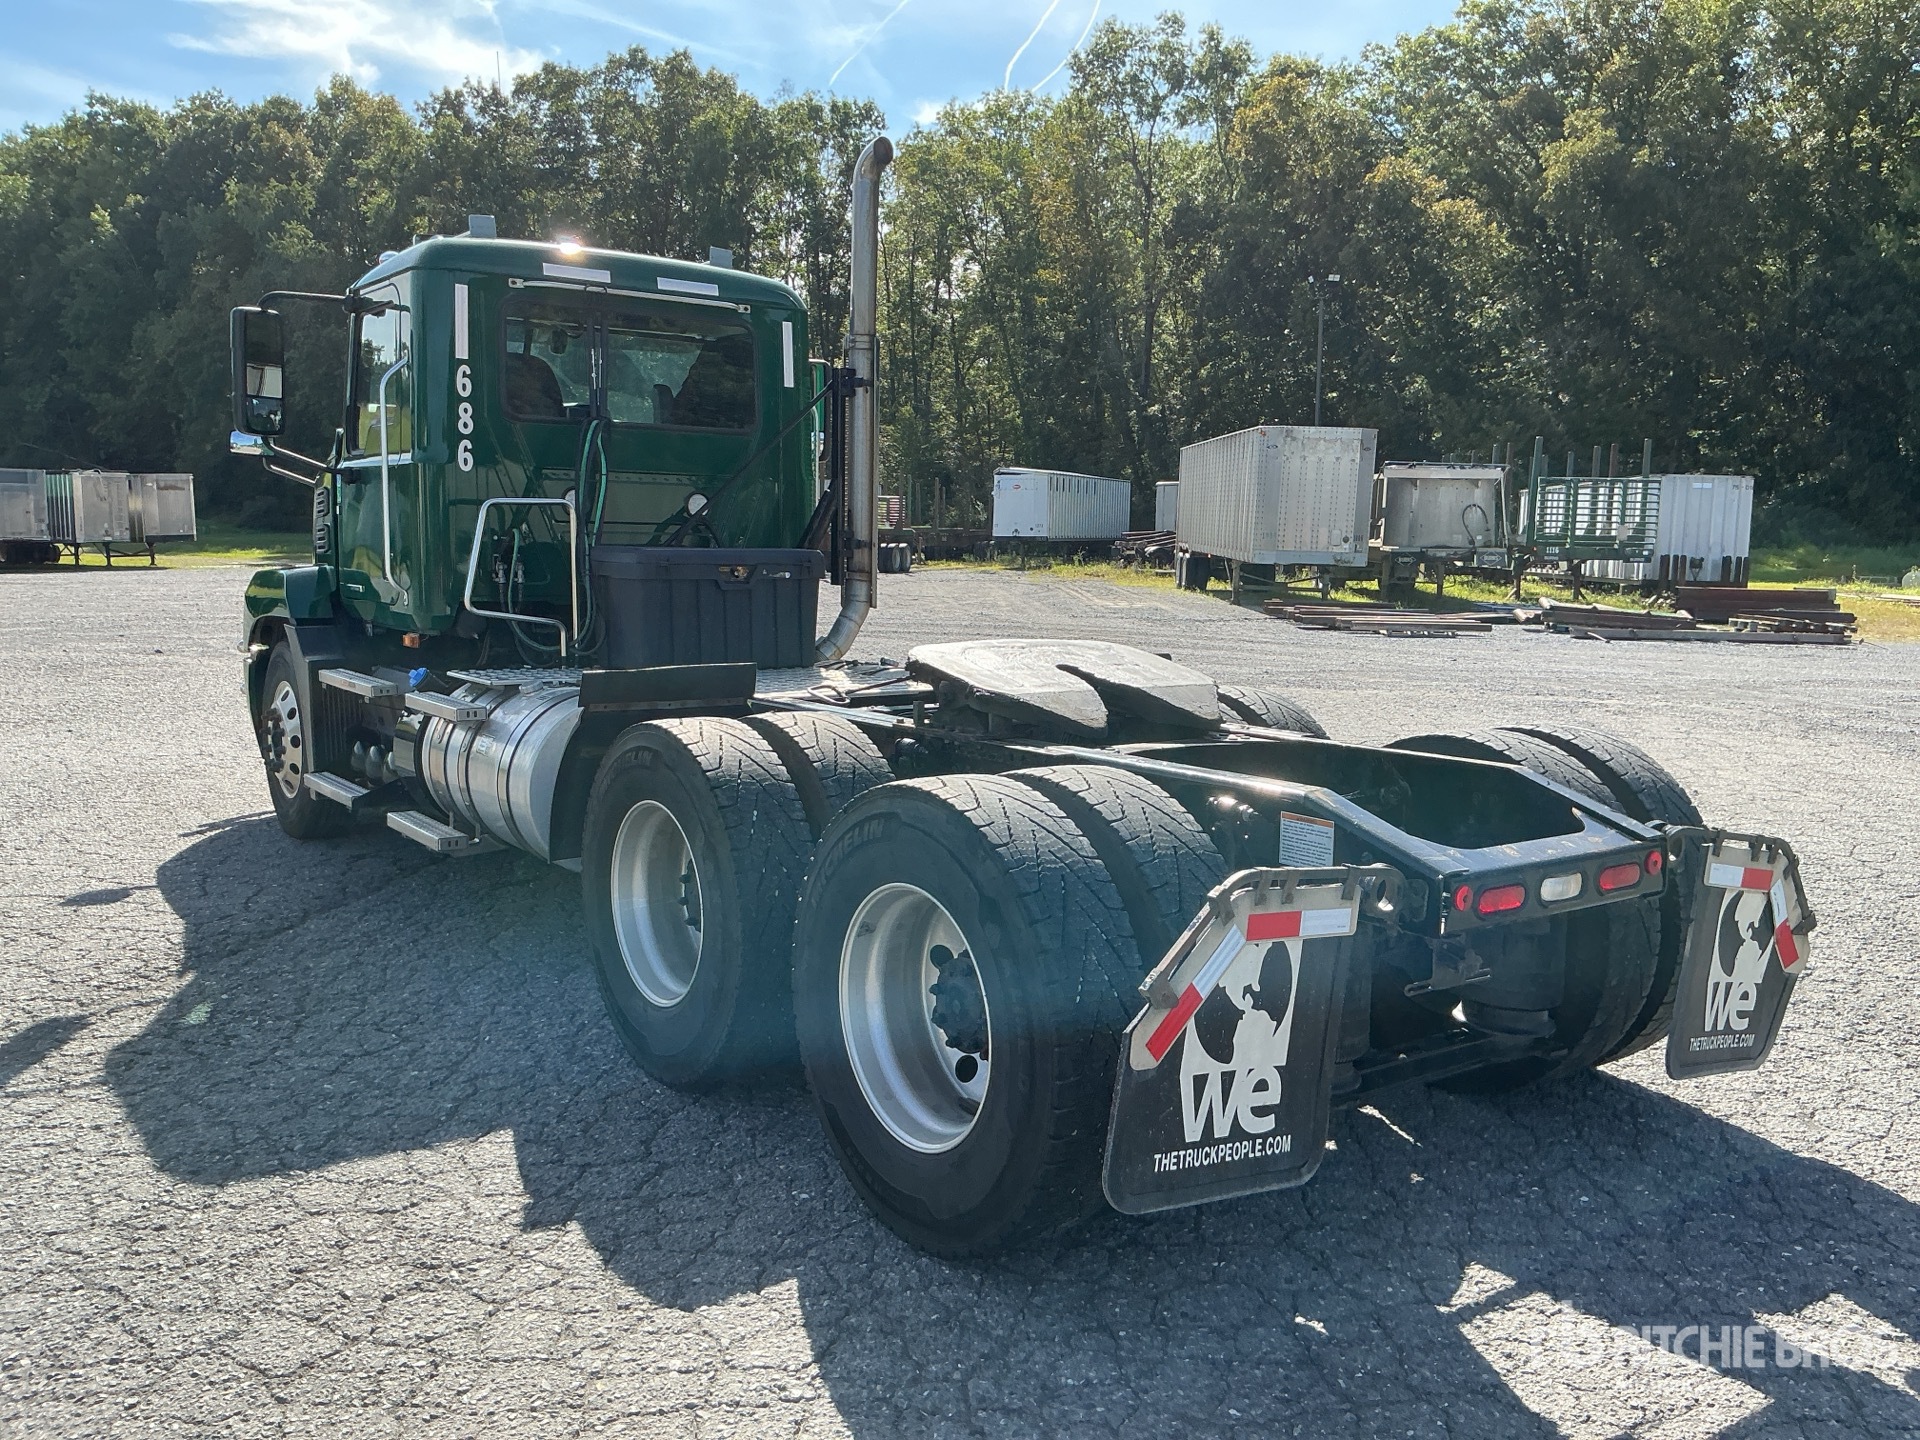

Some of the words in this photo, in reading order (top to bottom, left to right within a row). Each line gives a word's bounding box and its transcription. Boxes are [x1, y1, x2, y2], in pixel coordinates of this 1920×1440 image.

[456, 364, 474, 472] 686
[1689, 1034, 1755, 1052] THETRUCKPEOPLE.COM
[1153, 1135, 1292, 1172] THETRUCKPEOPLE.COM
